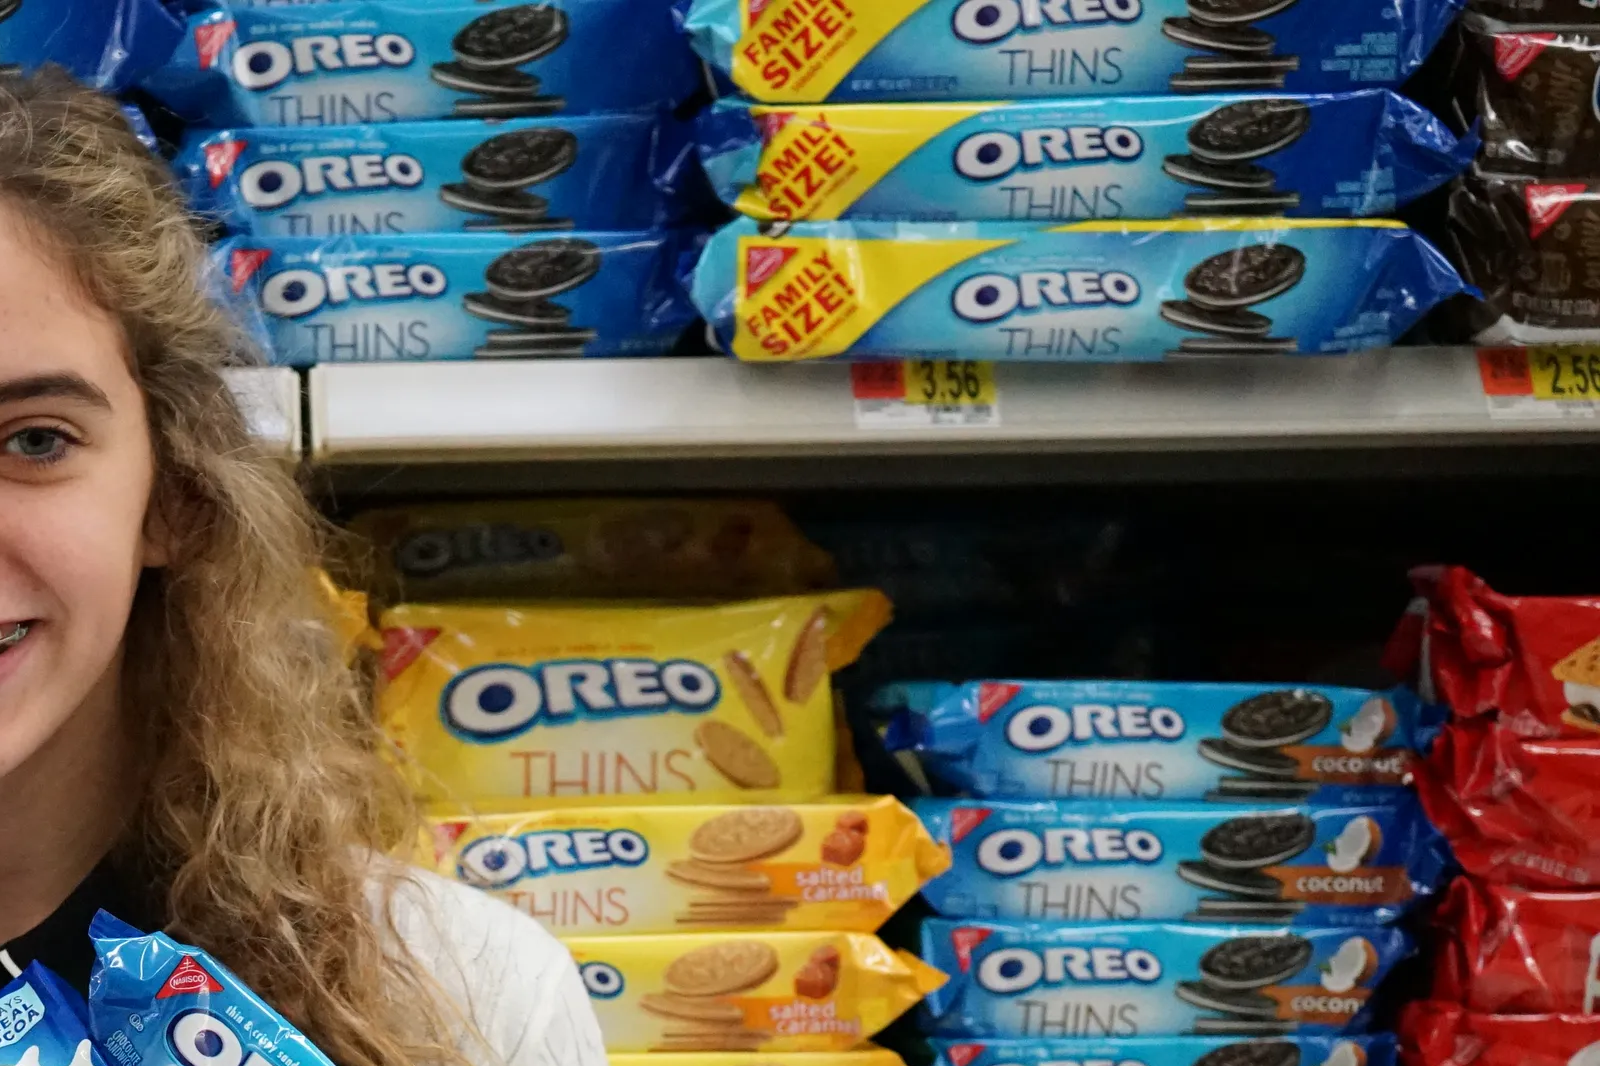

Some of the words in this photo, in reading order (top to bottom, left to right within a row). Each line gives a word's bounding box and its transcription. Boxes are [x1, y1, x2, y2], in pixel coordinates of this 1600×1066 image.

[953, 0, 1141, 42] OREO
[234, 34, 414, 89] OREO
[763, 3, 853, 90] SIZE!
[999, 48, 1122, 85] THINS
[269, 93, 395, 124] THINS
[956, 127, 1142, 178] OREO
[241, 153, 422, 208] OREO
[999, 186, 1123, 219] THINS
[264, 264, 445, 316] OREO
[747, 249, 835, 339] FAMILY
[953, 272, 1139, 320] OREO
[761, 275, 854, 356] SIZE!
[303, 321, 431, 361] THINS
[999, 329, 1122, 356] THINS
[446, 660, 719, 737] OREO
[1008, 705, 1184, 749] OREO
[511, 750, 695, 796] THINS
[1046, 759, 1165, 799] THINS
[1312, 756, 1399, 773] coconut
[461, 830, 647, 885] OREO
[978, 829, 1162, 874] OREO
[797, 869, 863, 886] salted
[803, 884, 888, 901] caramel
[1296, 876, 1385, 893] coconut
[1018, 881, 1141, 919] THINS
[173, 975, 204, 986] NABISCO
[980, 948, 1161, 990] OREO
[225, 1006, 244, 1025] thin
[243, 1021, 253, 1032] &
[252, 1029, 276, 1056] crispy
[770, 1003, 836, 1019] salted
[776, 1018, 860, 1034] caramel
[1015, 1002, 1138, 1037] THINS
[113, 1030, 141, 1066] CHOCOLATE
